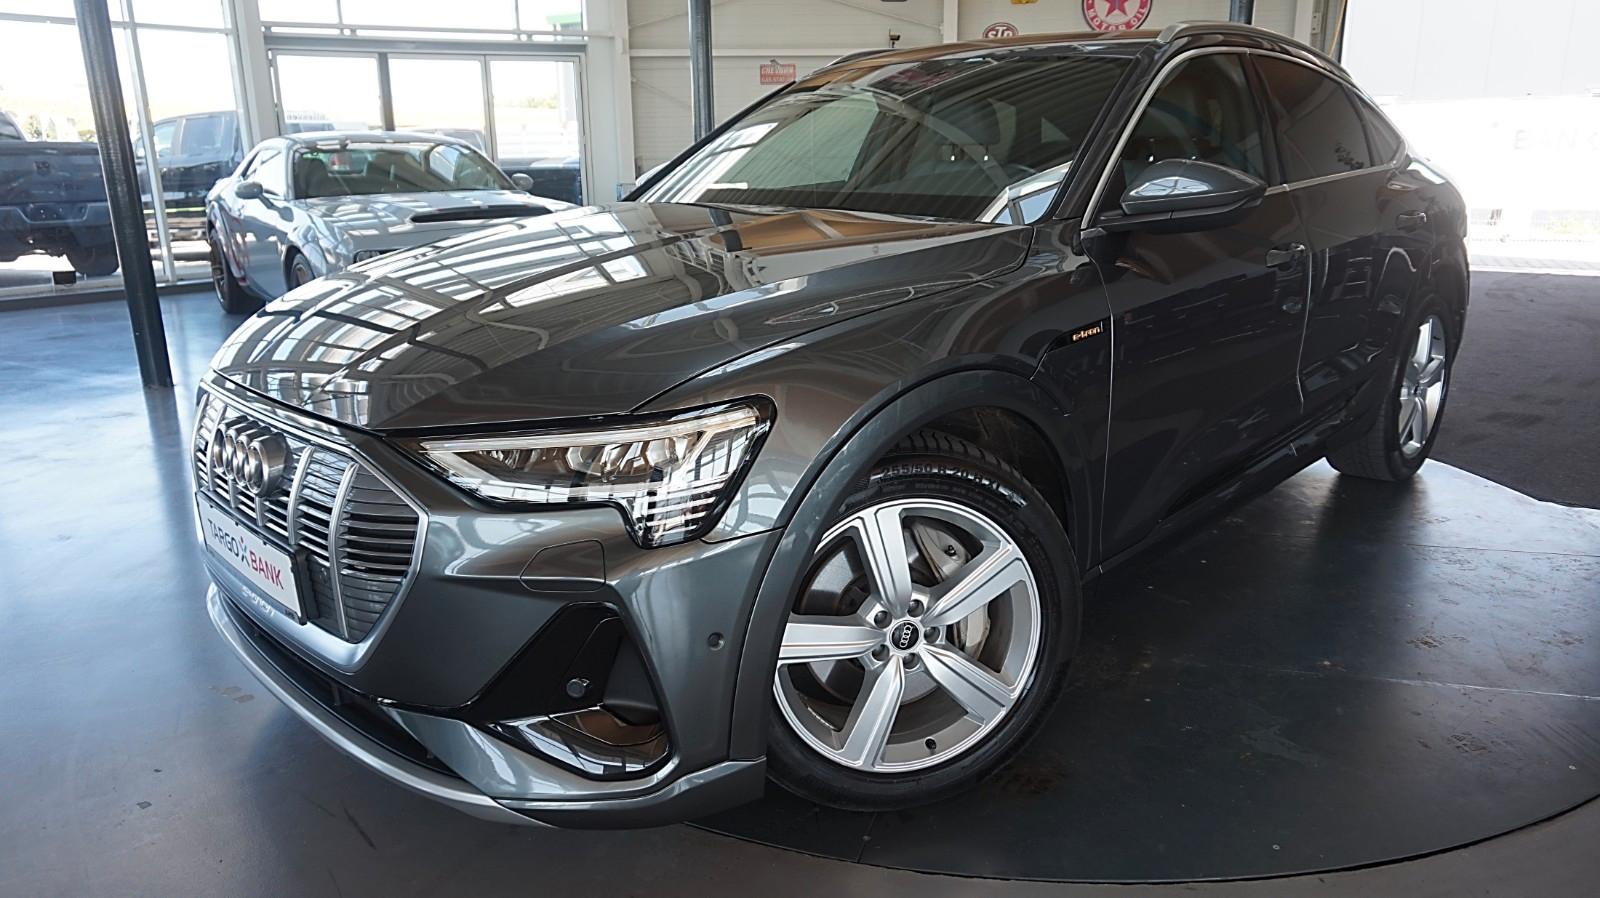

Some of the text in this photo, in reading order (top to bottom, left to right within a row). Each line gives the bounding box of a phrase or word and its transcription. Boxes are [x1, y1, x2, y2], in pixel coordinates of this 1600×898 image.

[1087, 7, 1147, 31] MOTOR OIL
[880, 463, 933, 479] 255/50
[951, 466, 970, 479] 20
[207, 518, 284, 591] TARGO BANK
